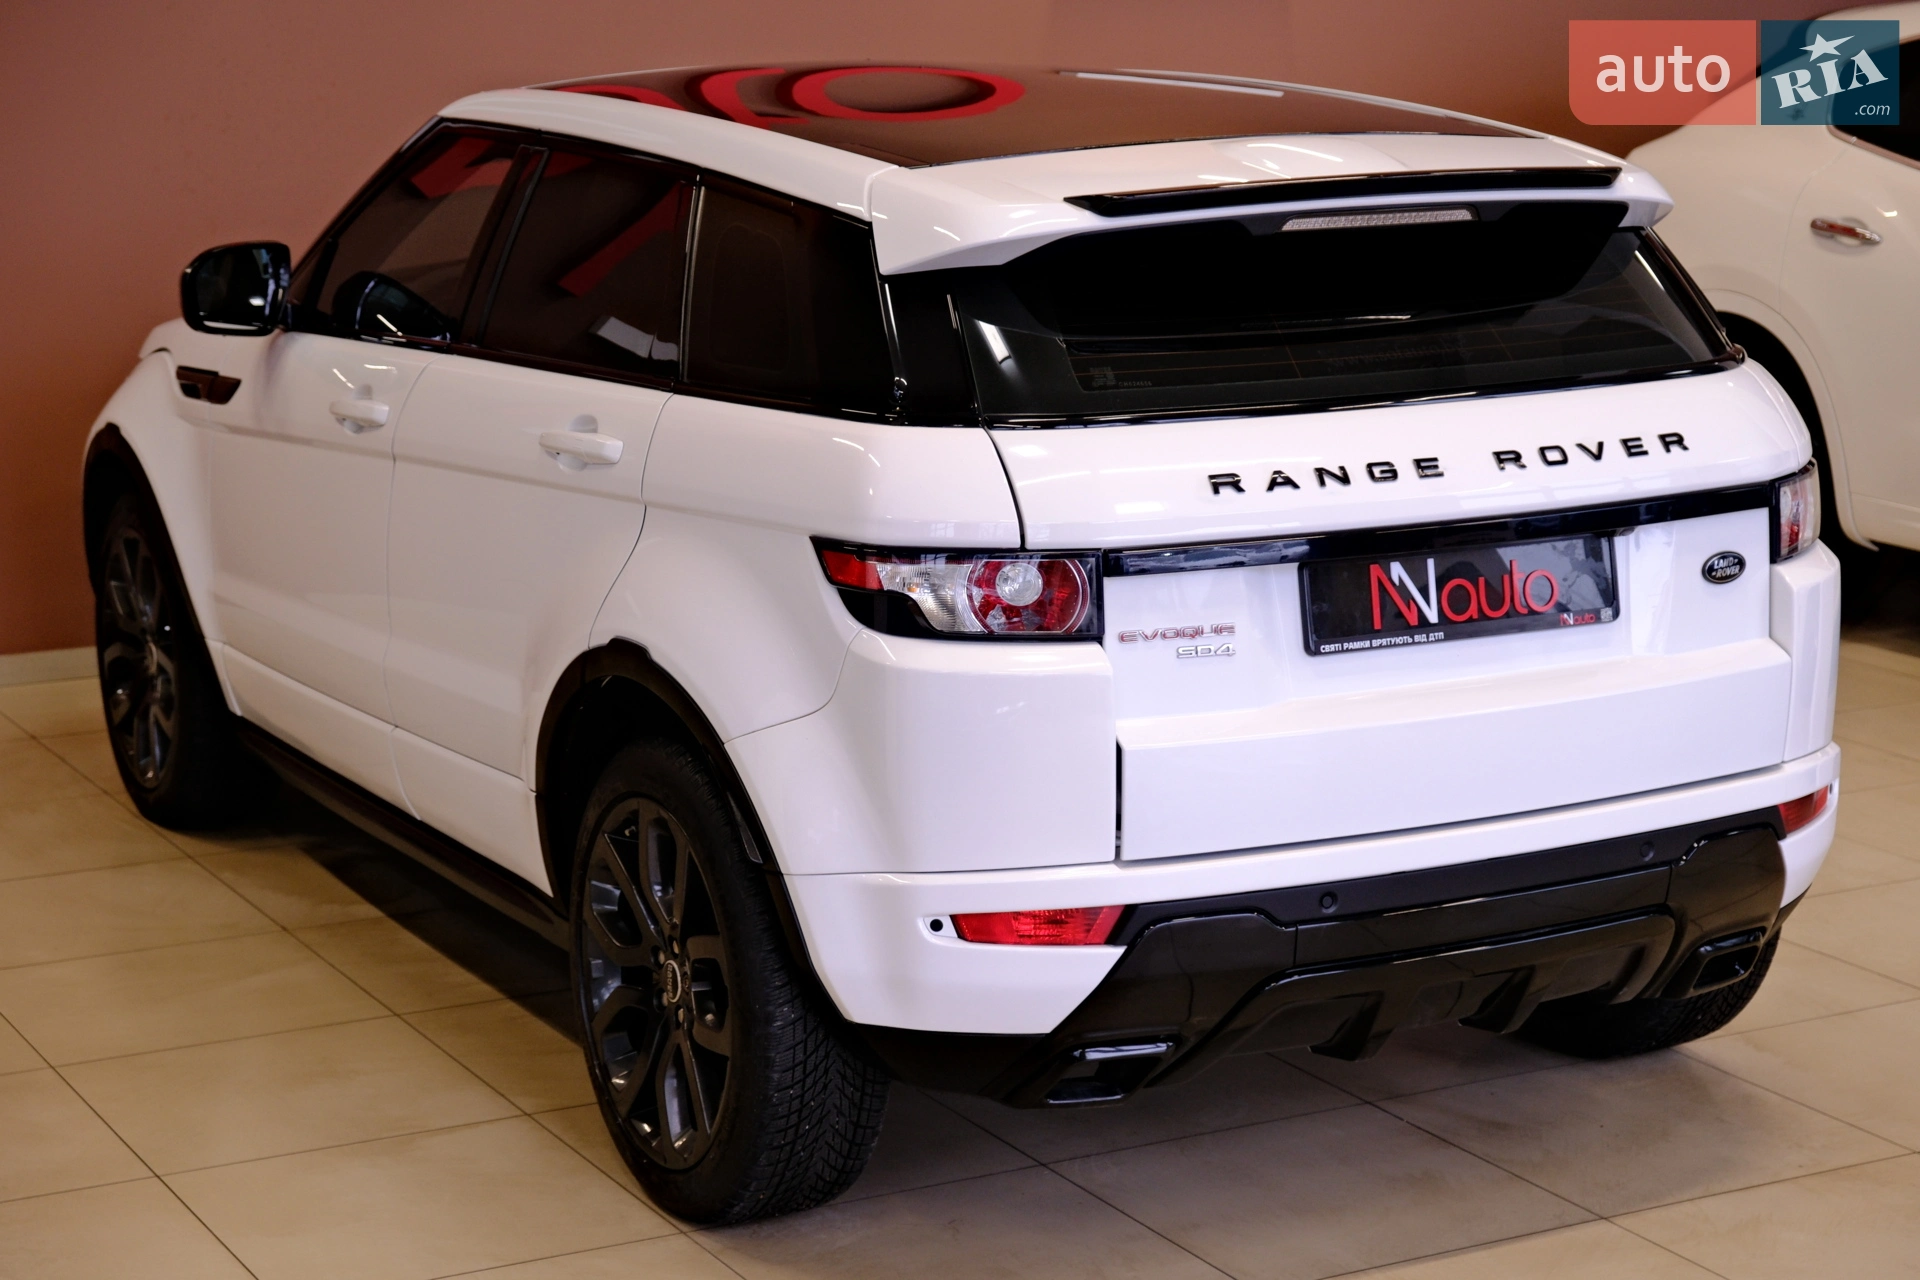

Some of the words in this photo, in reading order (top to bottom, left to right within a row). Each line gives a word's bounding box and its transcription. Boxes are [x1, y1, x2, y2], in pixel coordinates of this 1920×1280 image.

[1208, 457, 1445, 495] RANGE
[1492, 432, 1690, 471] ROVER
[1714, 557, 1734, 569] LAND
[1716, 565, 1740, 578] ROVER
[1118, 622, 1236, 643] EVOQUE
[1177, 643, 1236, 659] SD4
[1320, 643, 1342, 653] СВЯТІ
[1343, 640, 1371, 651] РАМКИ
[1372, 636, 1413, 648] ВРЯТУЮТЬ
[1414, 634, 1428, 643] ВІД
[1428, 631, 1445, 642] ДТП
